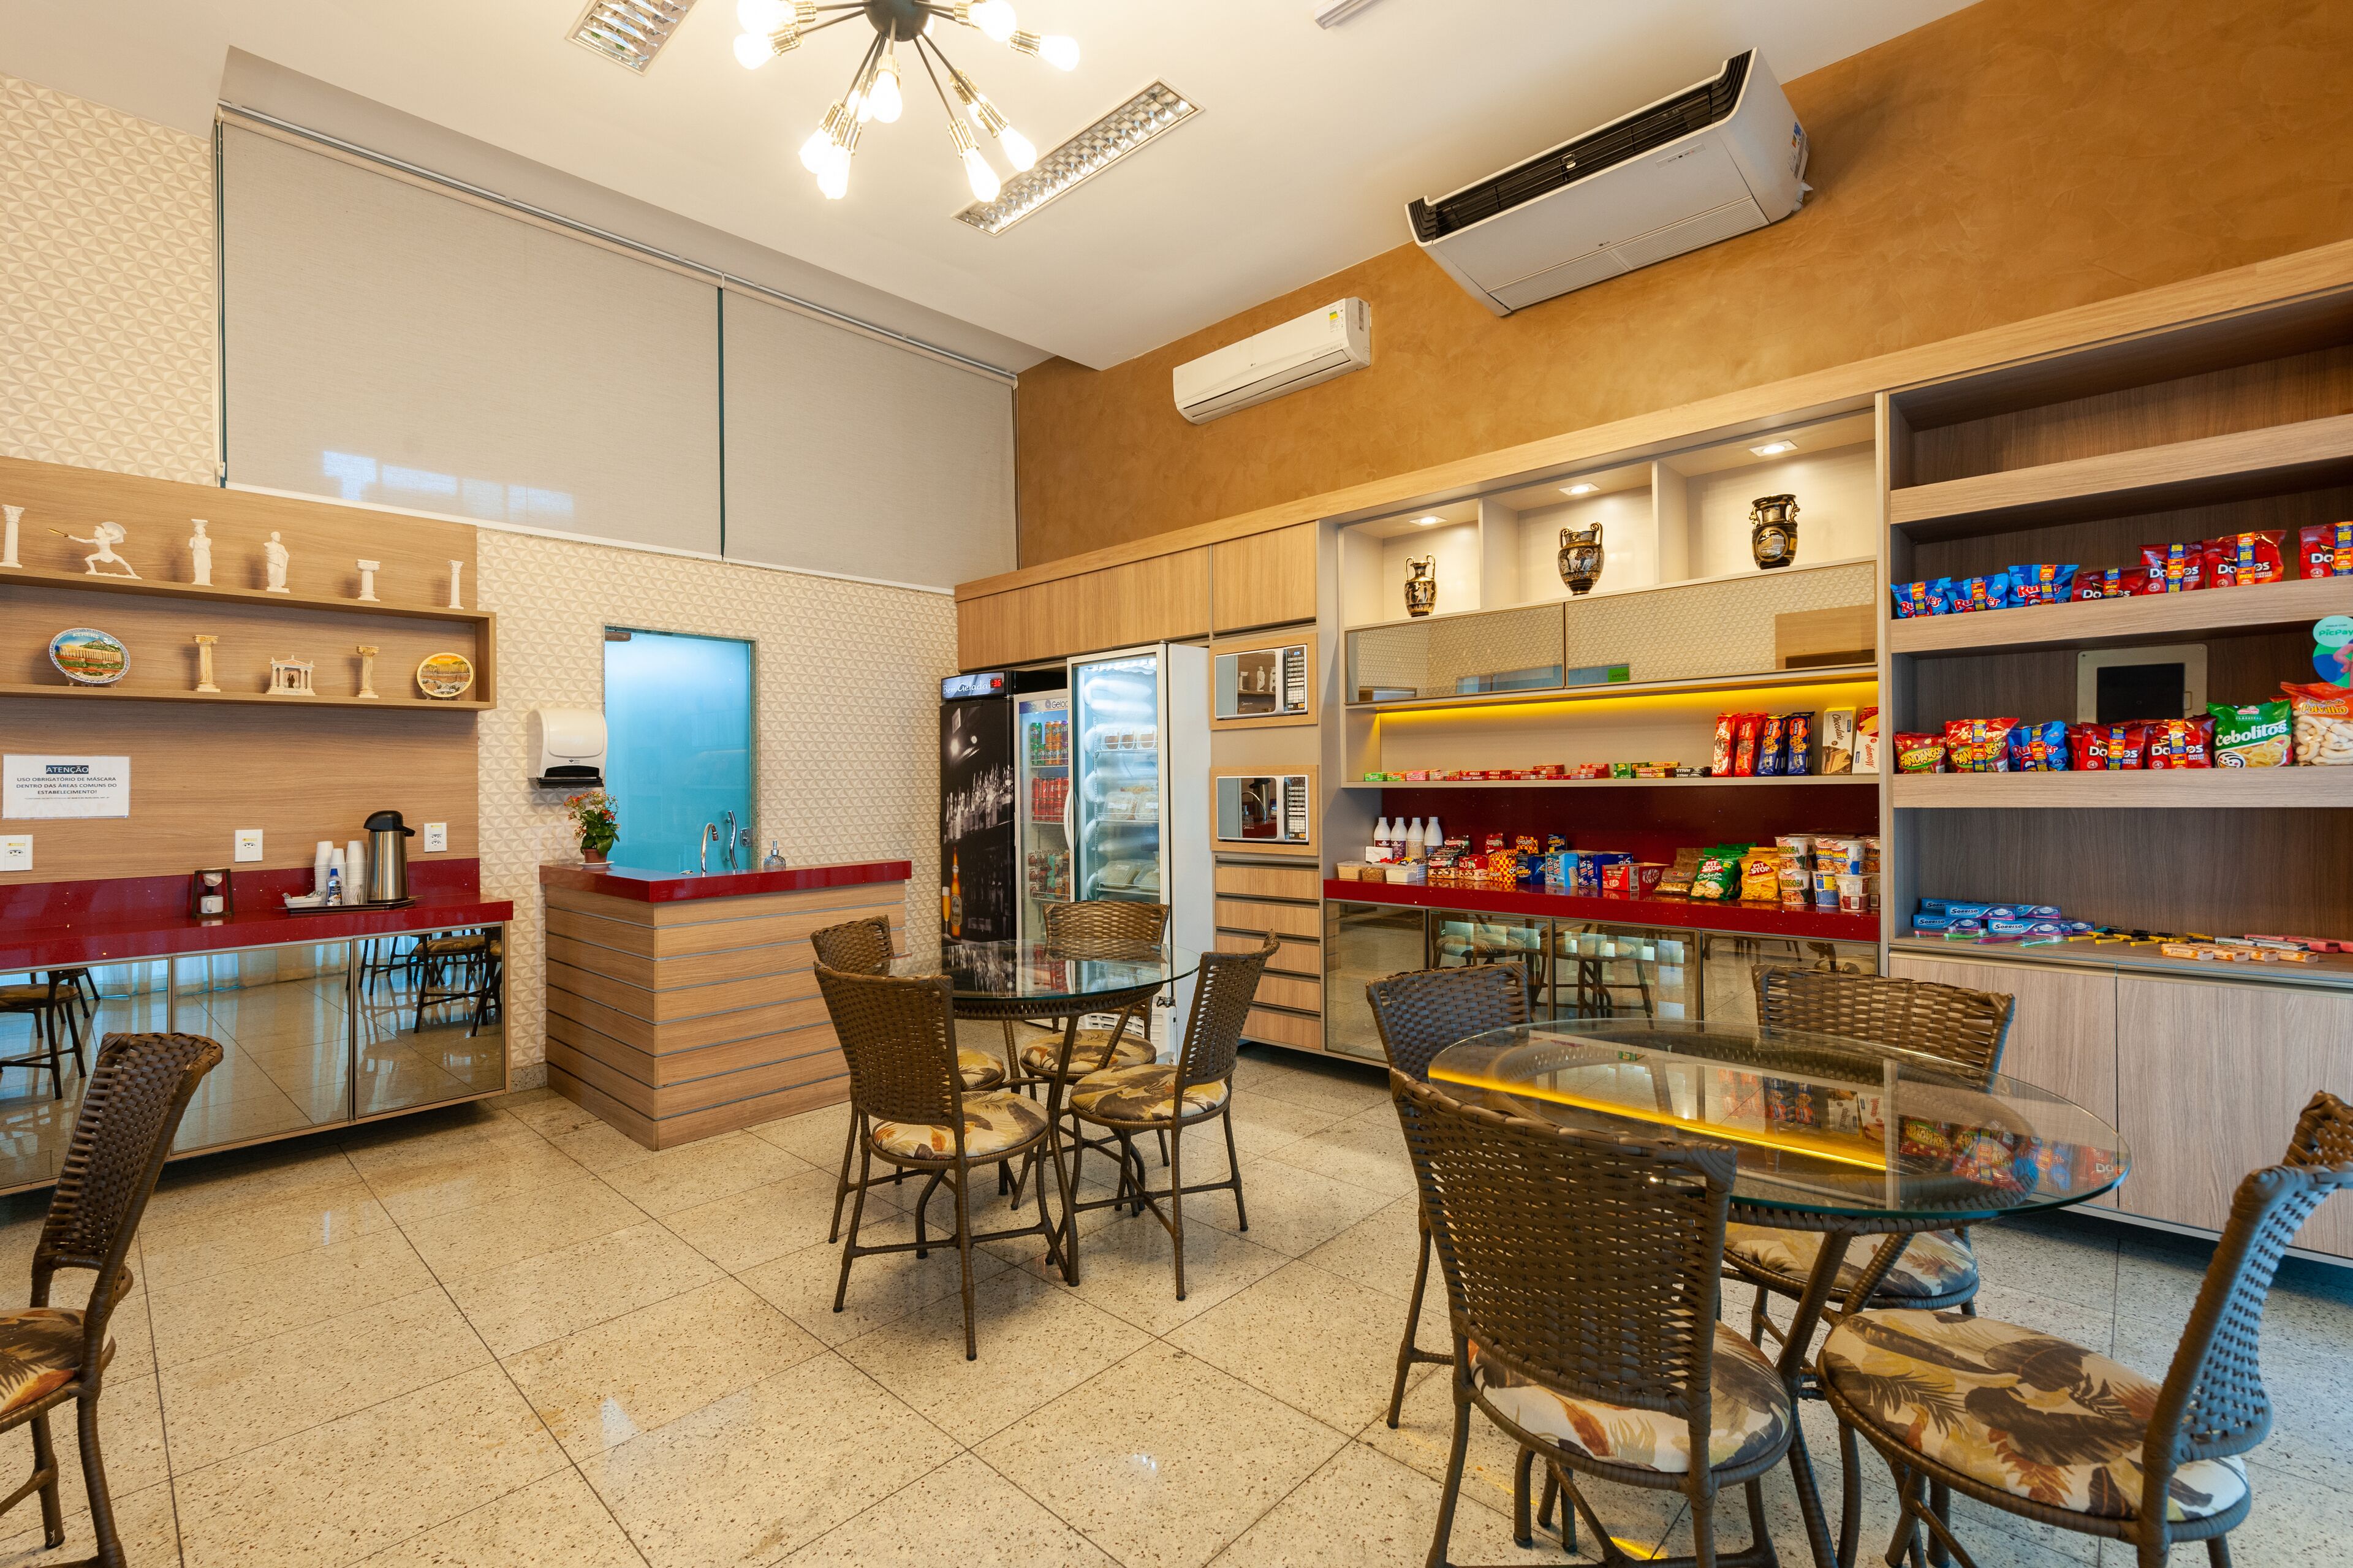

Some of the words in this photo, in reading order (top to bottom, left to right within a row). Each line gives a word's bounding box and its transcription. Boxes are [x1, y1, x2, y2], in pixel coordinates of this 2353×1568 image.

[2150, 566, 2199, 578] Doos
[2218, 562, 2270, 574] Doos
[2083, 589, 2131, 598] Doos
[942, 684, 956, 694] Bem
[2302, 704, 2347, 714] Polvilho
[1832, 714, 1844, 740] Chocolate
[2216, 722, 2287, 746] Cebolitos
[1865, 744, 1875, 768] Morango
[1952, 741, 2006, 764] FANNGOS
[2090, 746, 2138, 758] Doos
[2151, 745, 2203, 756] Doos
[1900, 747, 1946, 767] FANDANGOS
[1751, 866, 1770, 874] STOP
